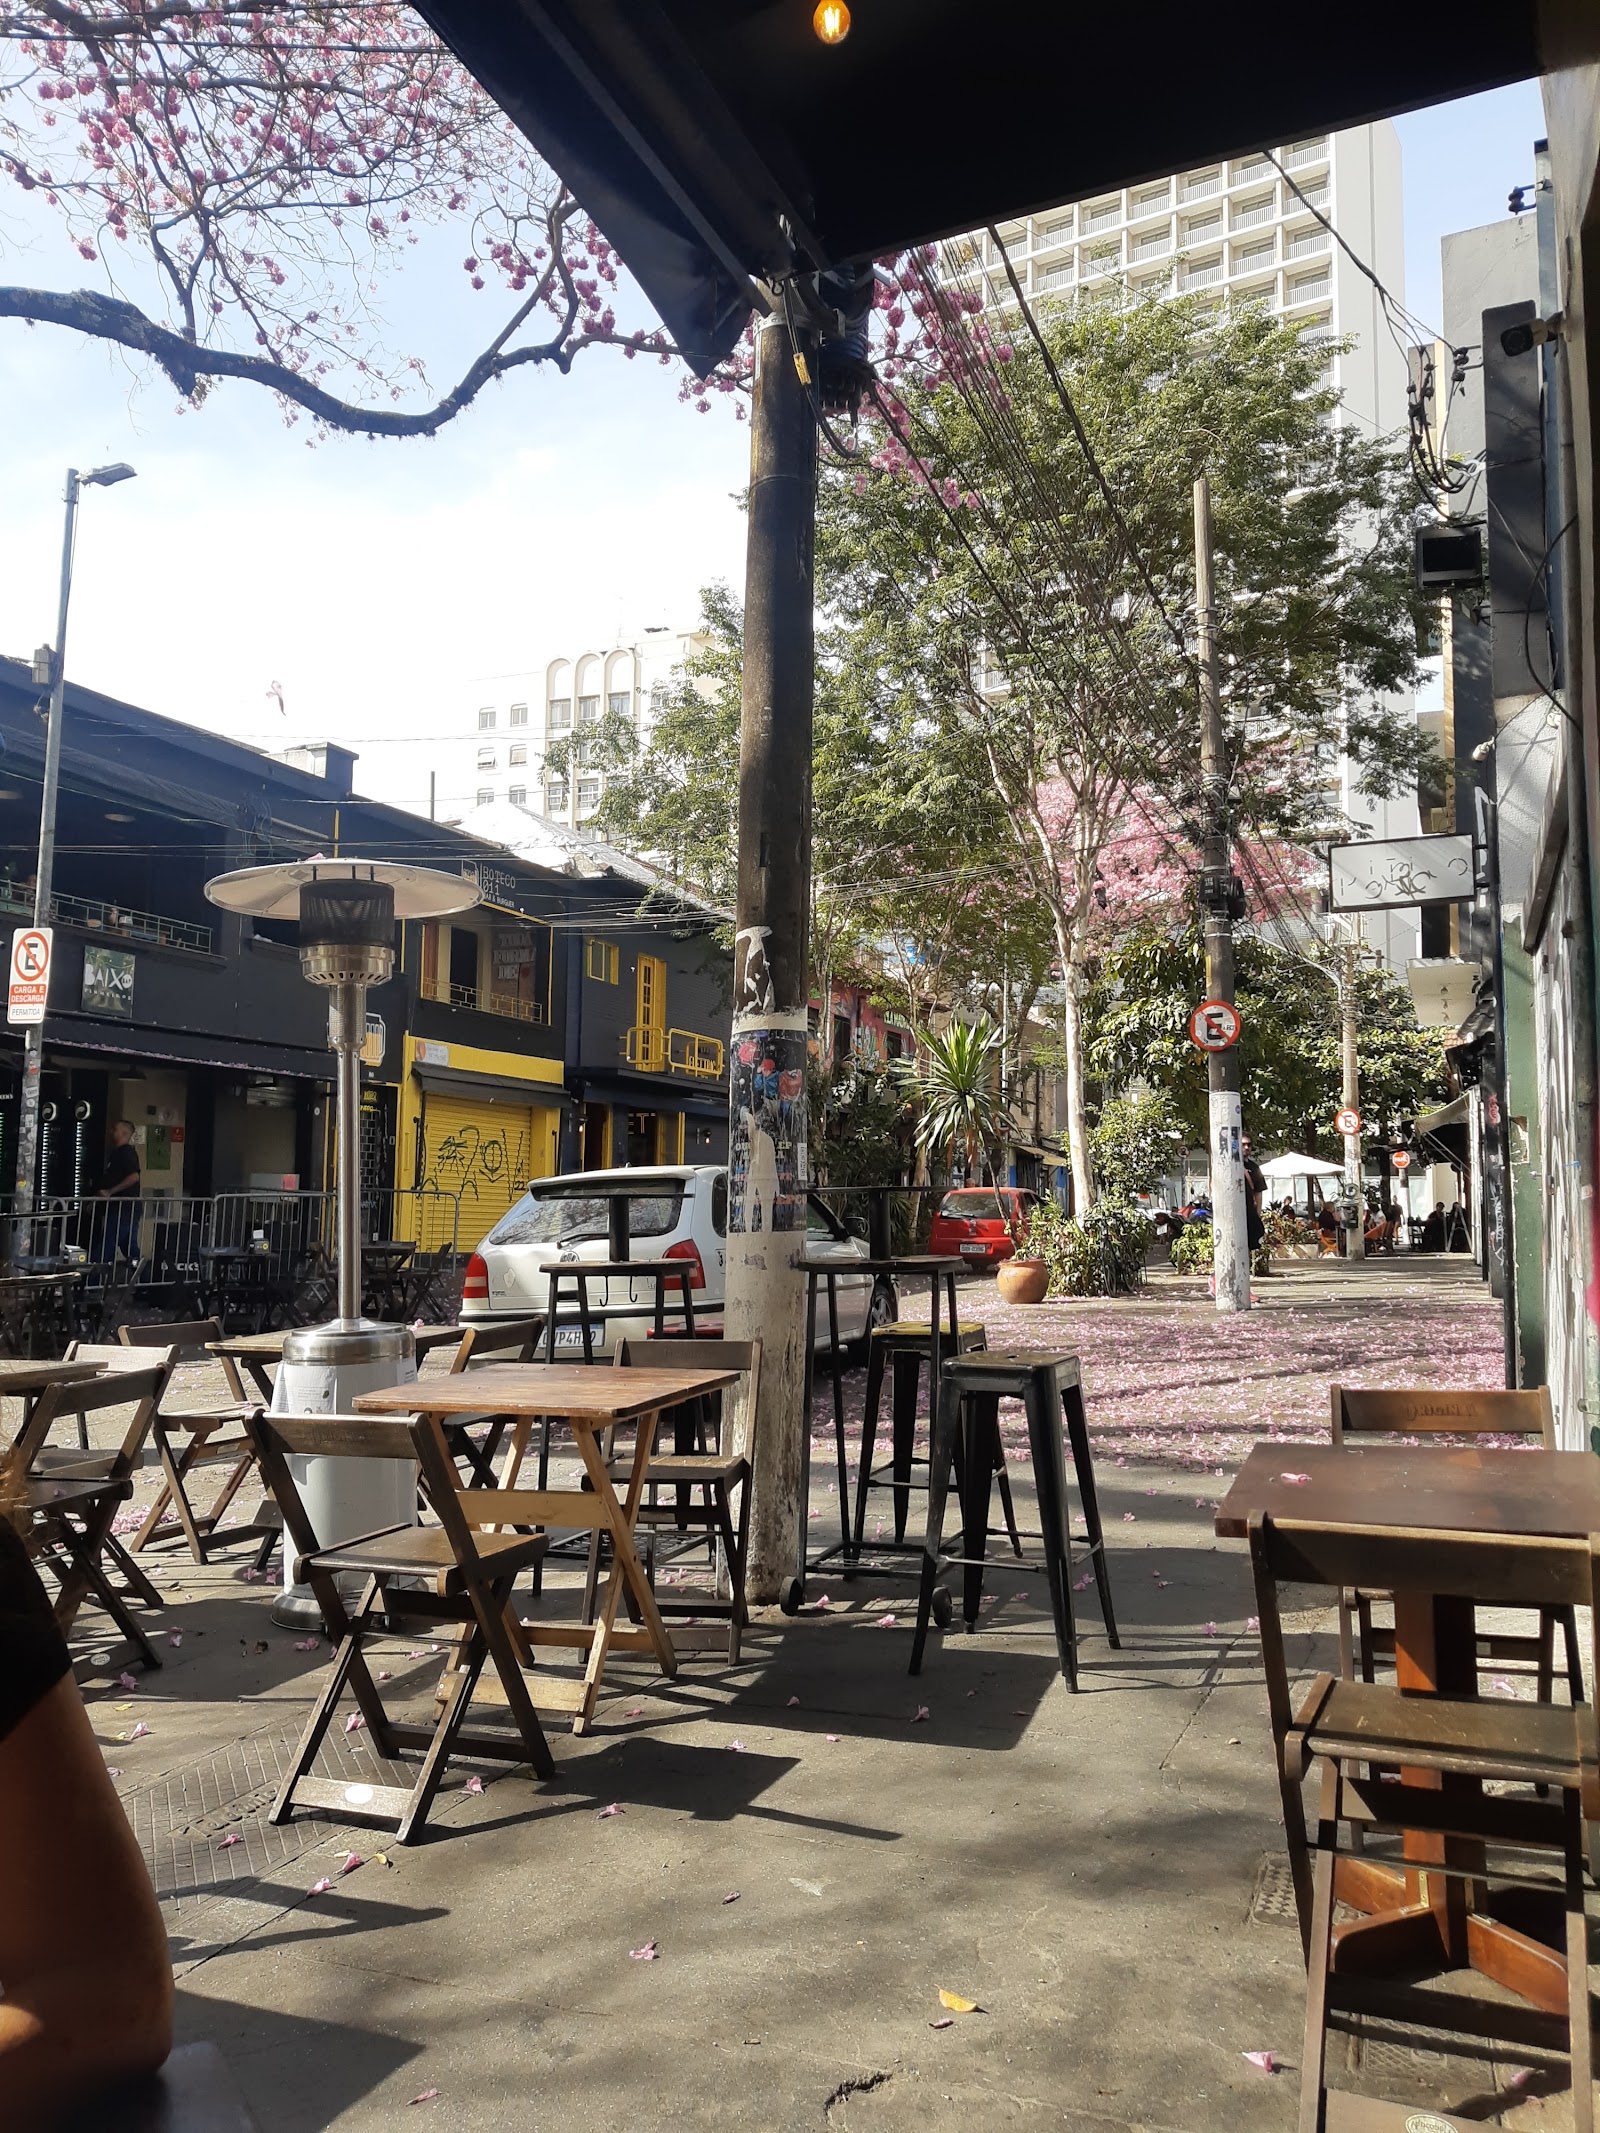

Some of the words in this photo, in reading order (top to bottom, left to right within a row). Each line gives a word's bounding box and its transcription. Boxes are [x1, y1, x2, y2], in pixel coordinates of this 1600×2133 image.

[482, 865, 516, 889] BOTECO
[482, 879, 500, 896] 011
[14, 986, 36, 994] CARGA
[39, 985, 45, 994] E
[11, 994, 44, 1003] DESCARGA
[11, 1008, 41, 1016] PERMITIDA
